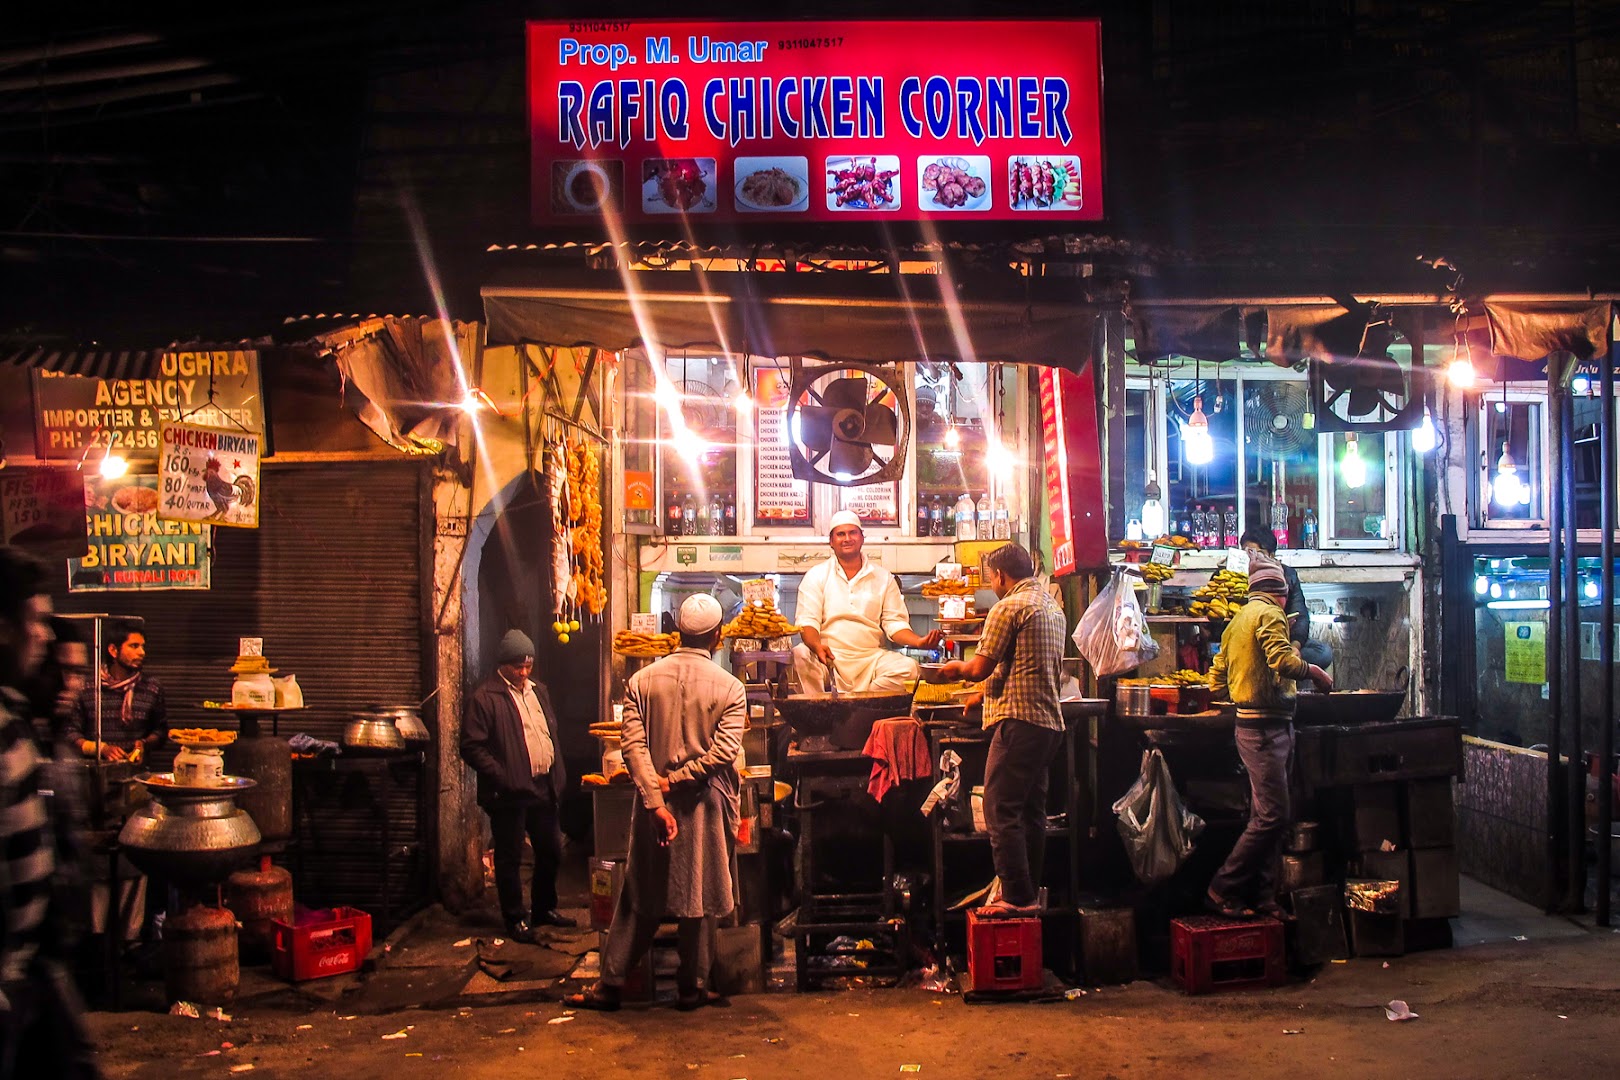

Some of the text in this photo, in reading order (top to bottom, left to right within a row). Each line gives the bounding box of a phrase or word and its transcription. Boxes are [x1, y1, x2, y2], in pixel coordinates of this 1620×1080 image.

[568, 22, 631, 33] 9311047517
[558, 35, 769, 71] Prop. M. Umar
[777, 37, 844, 50] 9311047517
[557, 74, 1075, 151] RAFIQ CHICKEN CORNER
[160, 351, 249, 377] UGHRA
[95, 380, 196, 406] AGENCY
[43, 408, 254, 428] IMPORTER & EXPORTER
[50, 430, 161, 448] PH: 232456
[163, 427, 257, 455] CHICKEN BIRYANI
[81, 543, 196, 567] BIRYANI
